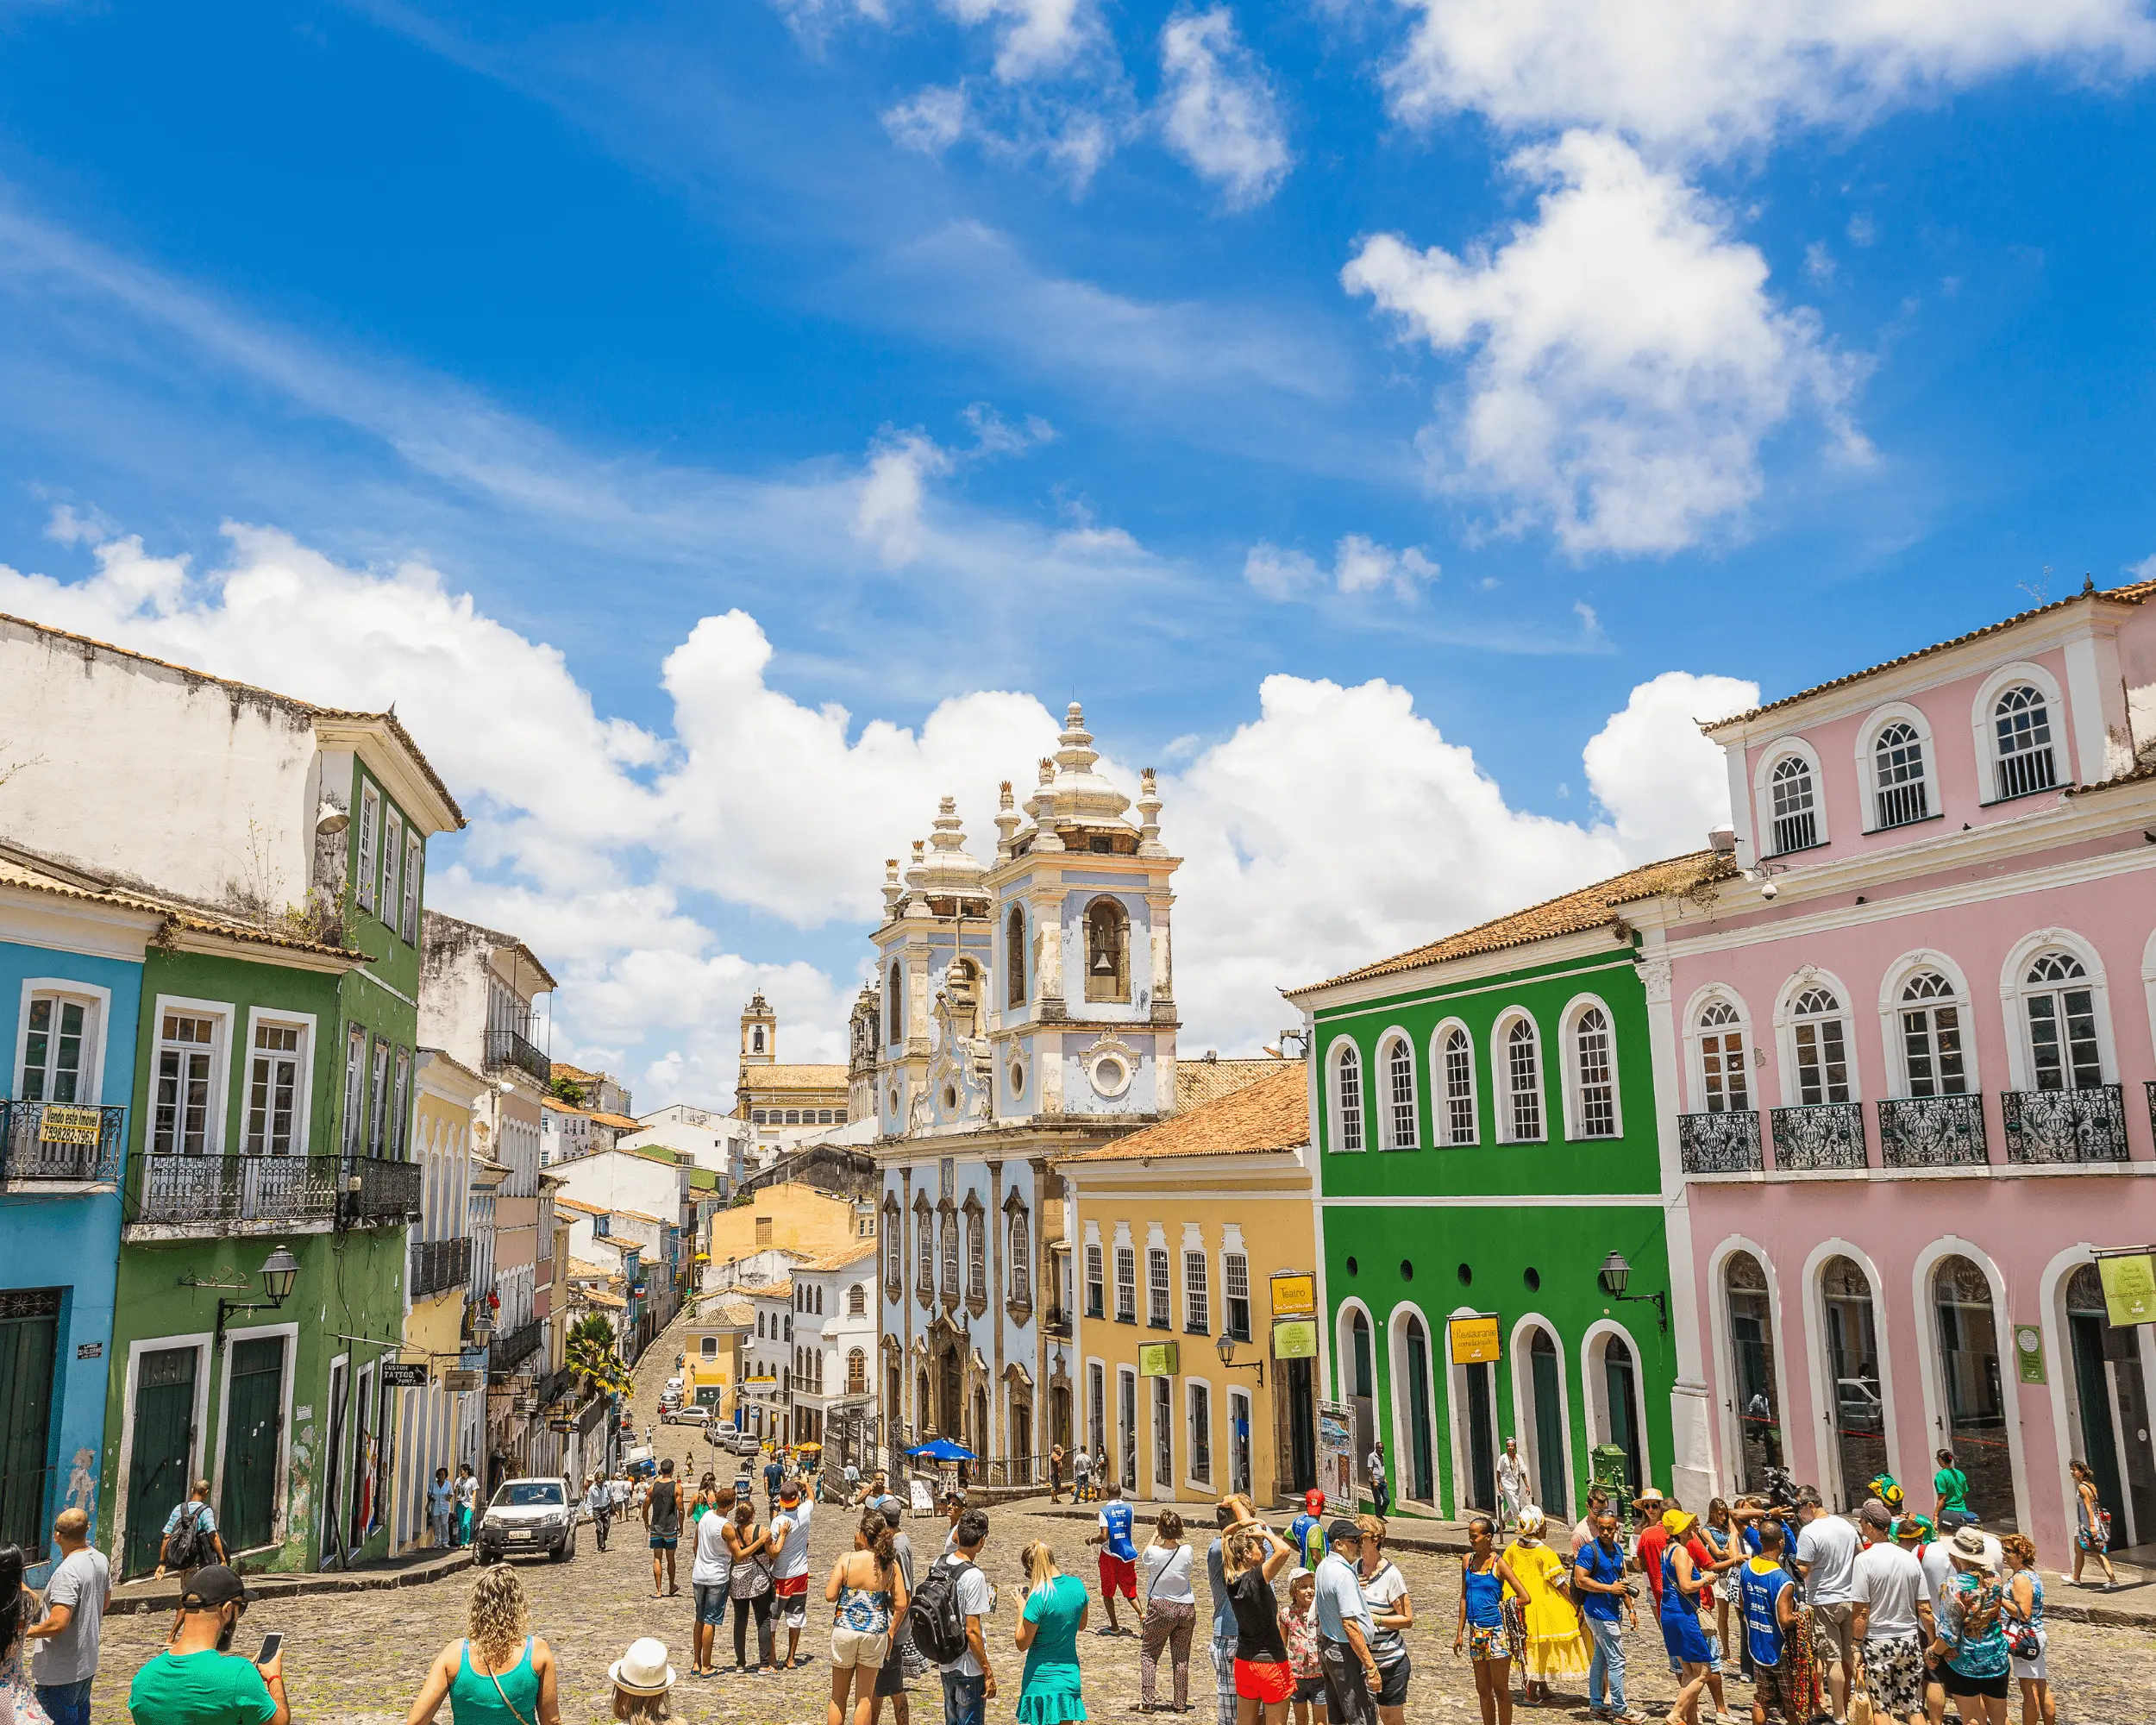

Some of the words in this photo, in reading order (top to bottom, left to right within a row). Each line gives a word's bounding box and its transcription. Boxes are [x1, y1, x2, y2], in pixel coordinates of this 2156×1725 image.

[47, 1108, 65, 1124] Vendo
[66, 1111, 78, 1125] este
[78, 1111, 98, 1127] Imóvel
